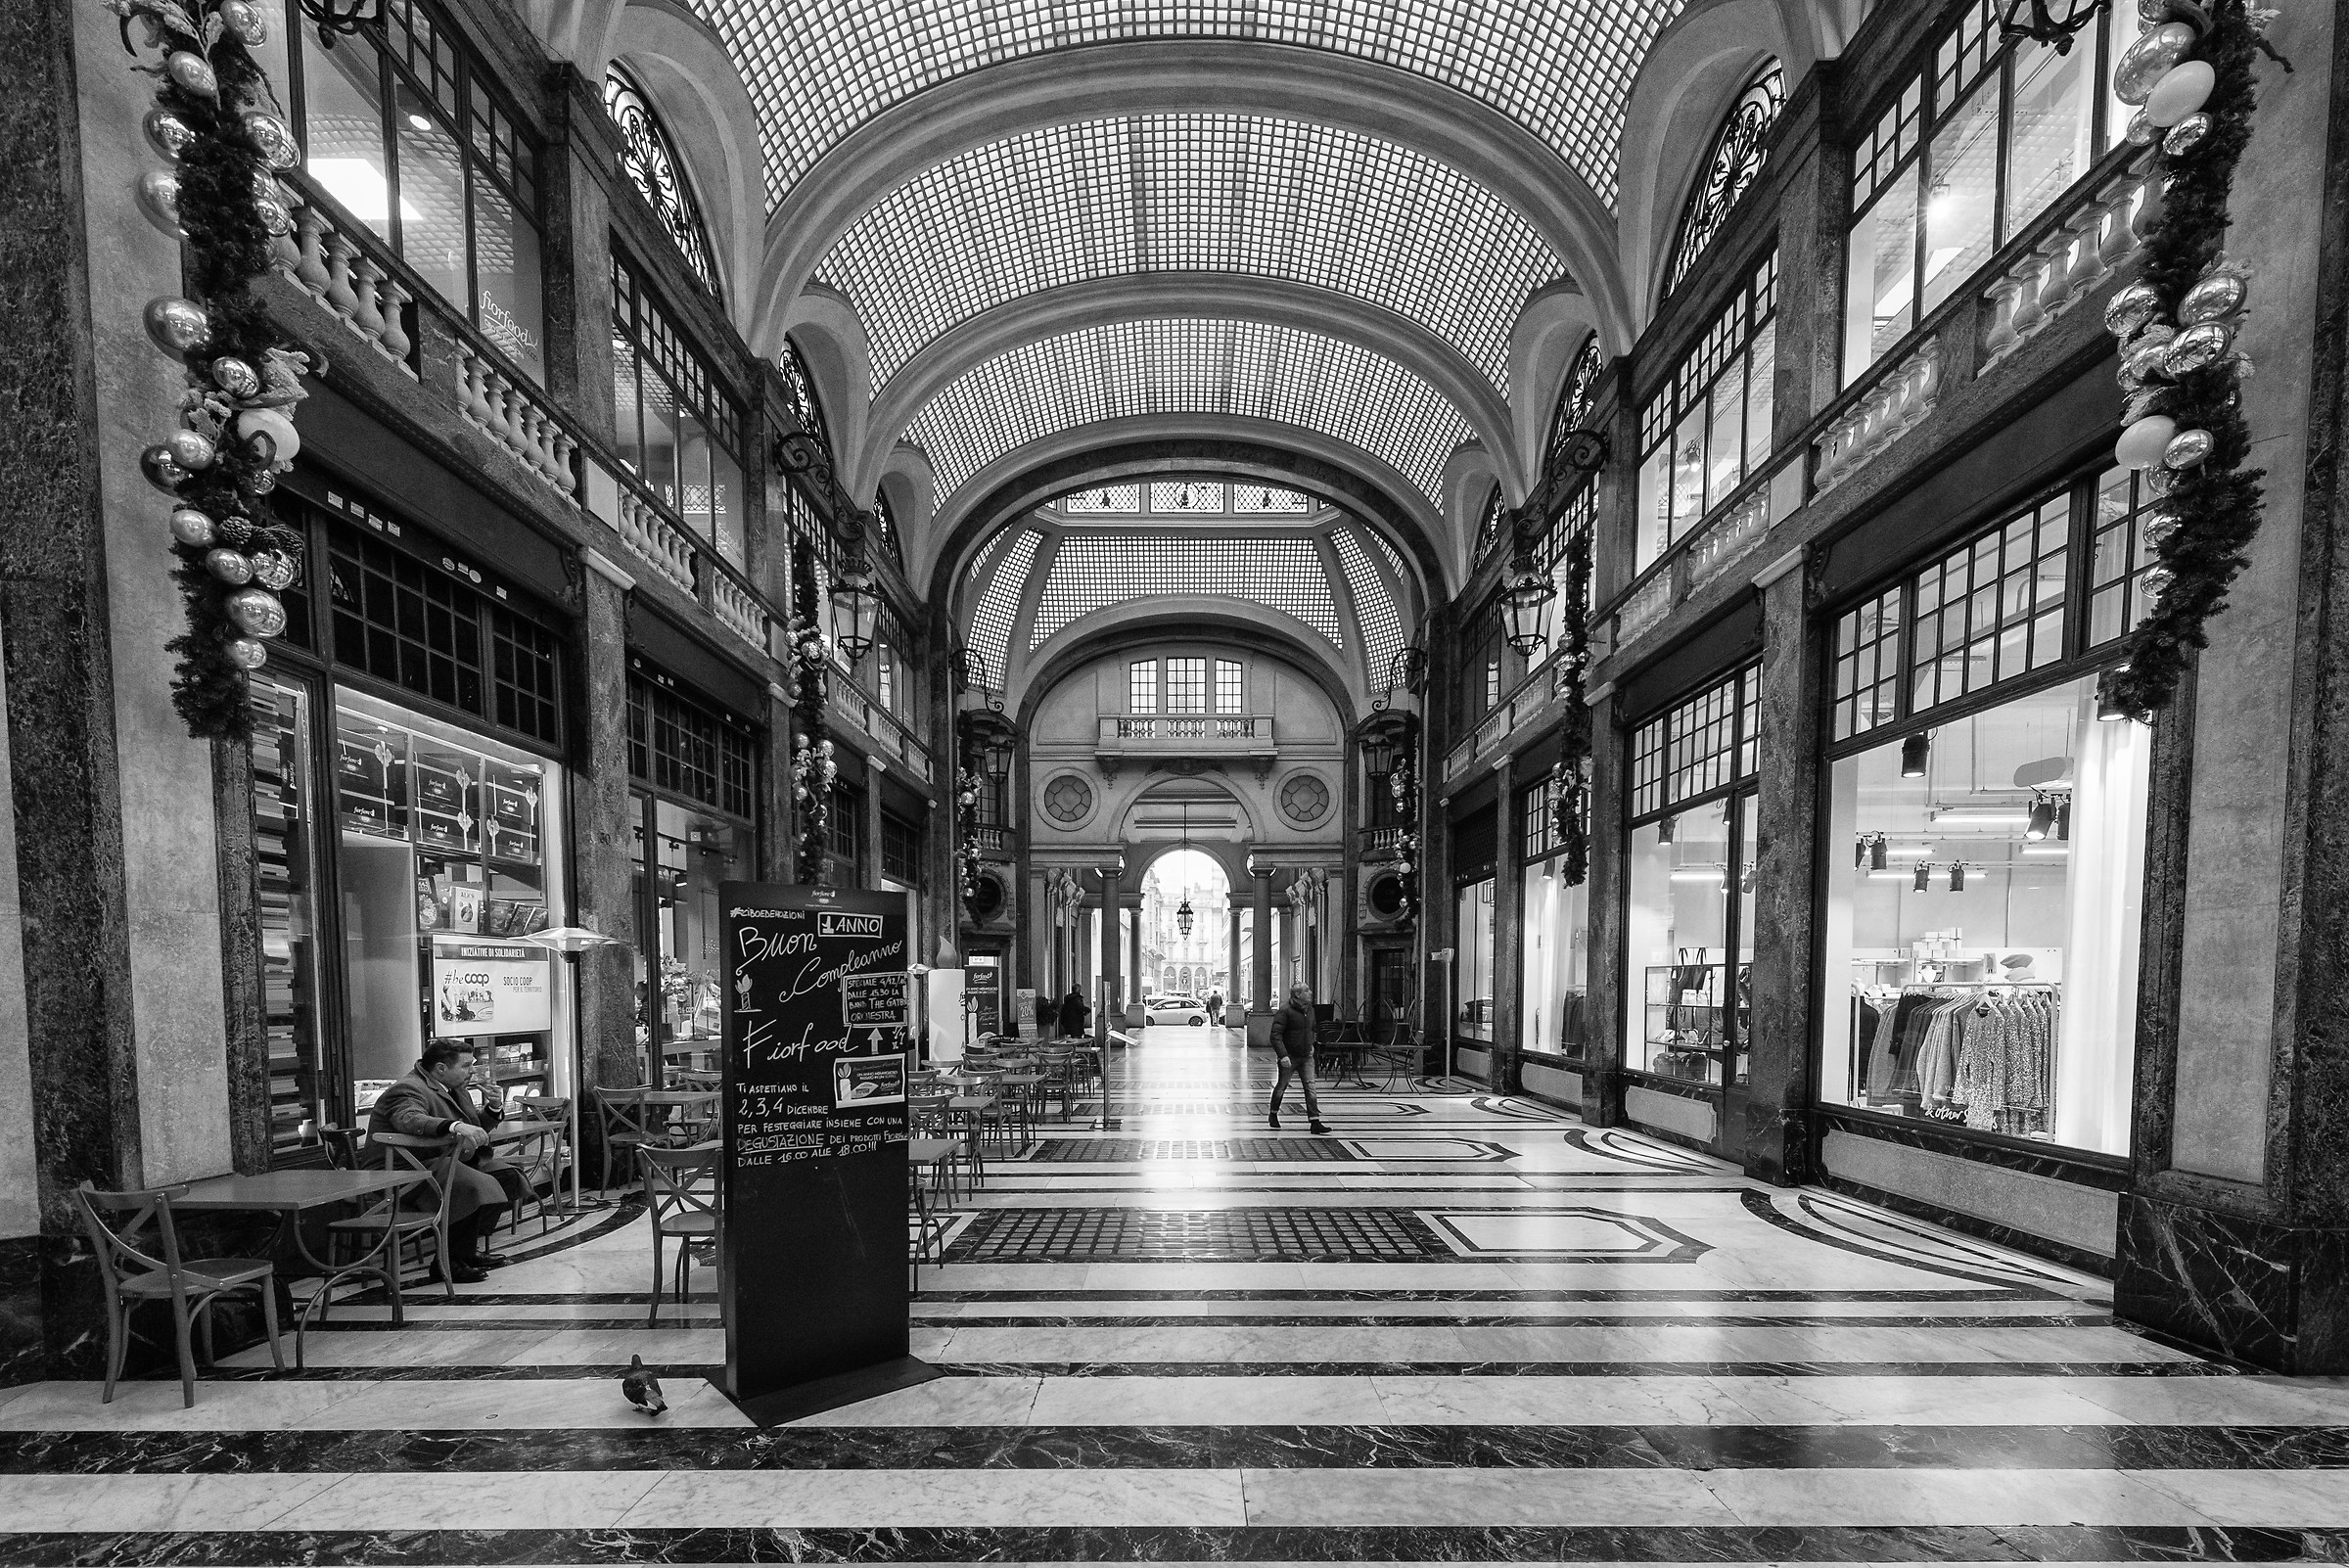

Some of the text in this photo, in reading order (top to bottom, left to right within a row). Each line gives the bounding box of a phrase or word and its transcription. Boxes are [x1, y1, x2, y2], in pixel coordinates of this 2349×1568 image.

[481, 291, 536, 347] fiorfood
[822, 916, 880, 934] 1 ANNO
[461, 946, 488, 957] INIZIATIVE
[489, 947, 494, 957] DI
[735, 927, 817, 976] Buon
[779, 941, 902, 1003] Compleanno
[743, 1019, 858, 1069] Fiorfood
[737, 1124, 758, 1133] PER
[866, 1117, 884, 1126] CON
[737, 1133, 825, 1152] DEGUSTAZIONE
[738, 1155, 772, 1167] DALLE
[811, 1147, 832, 1157] ALLE
